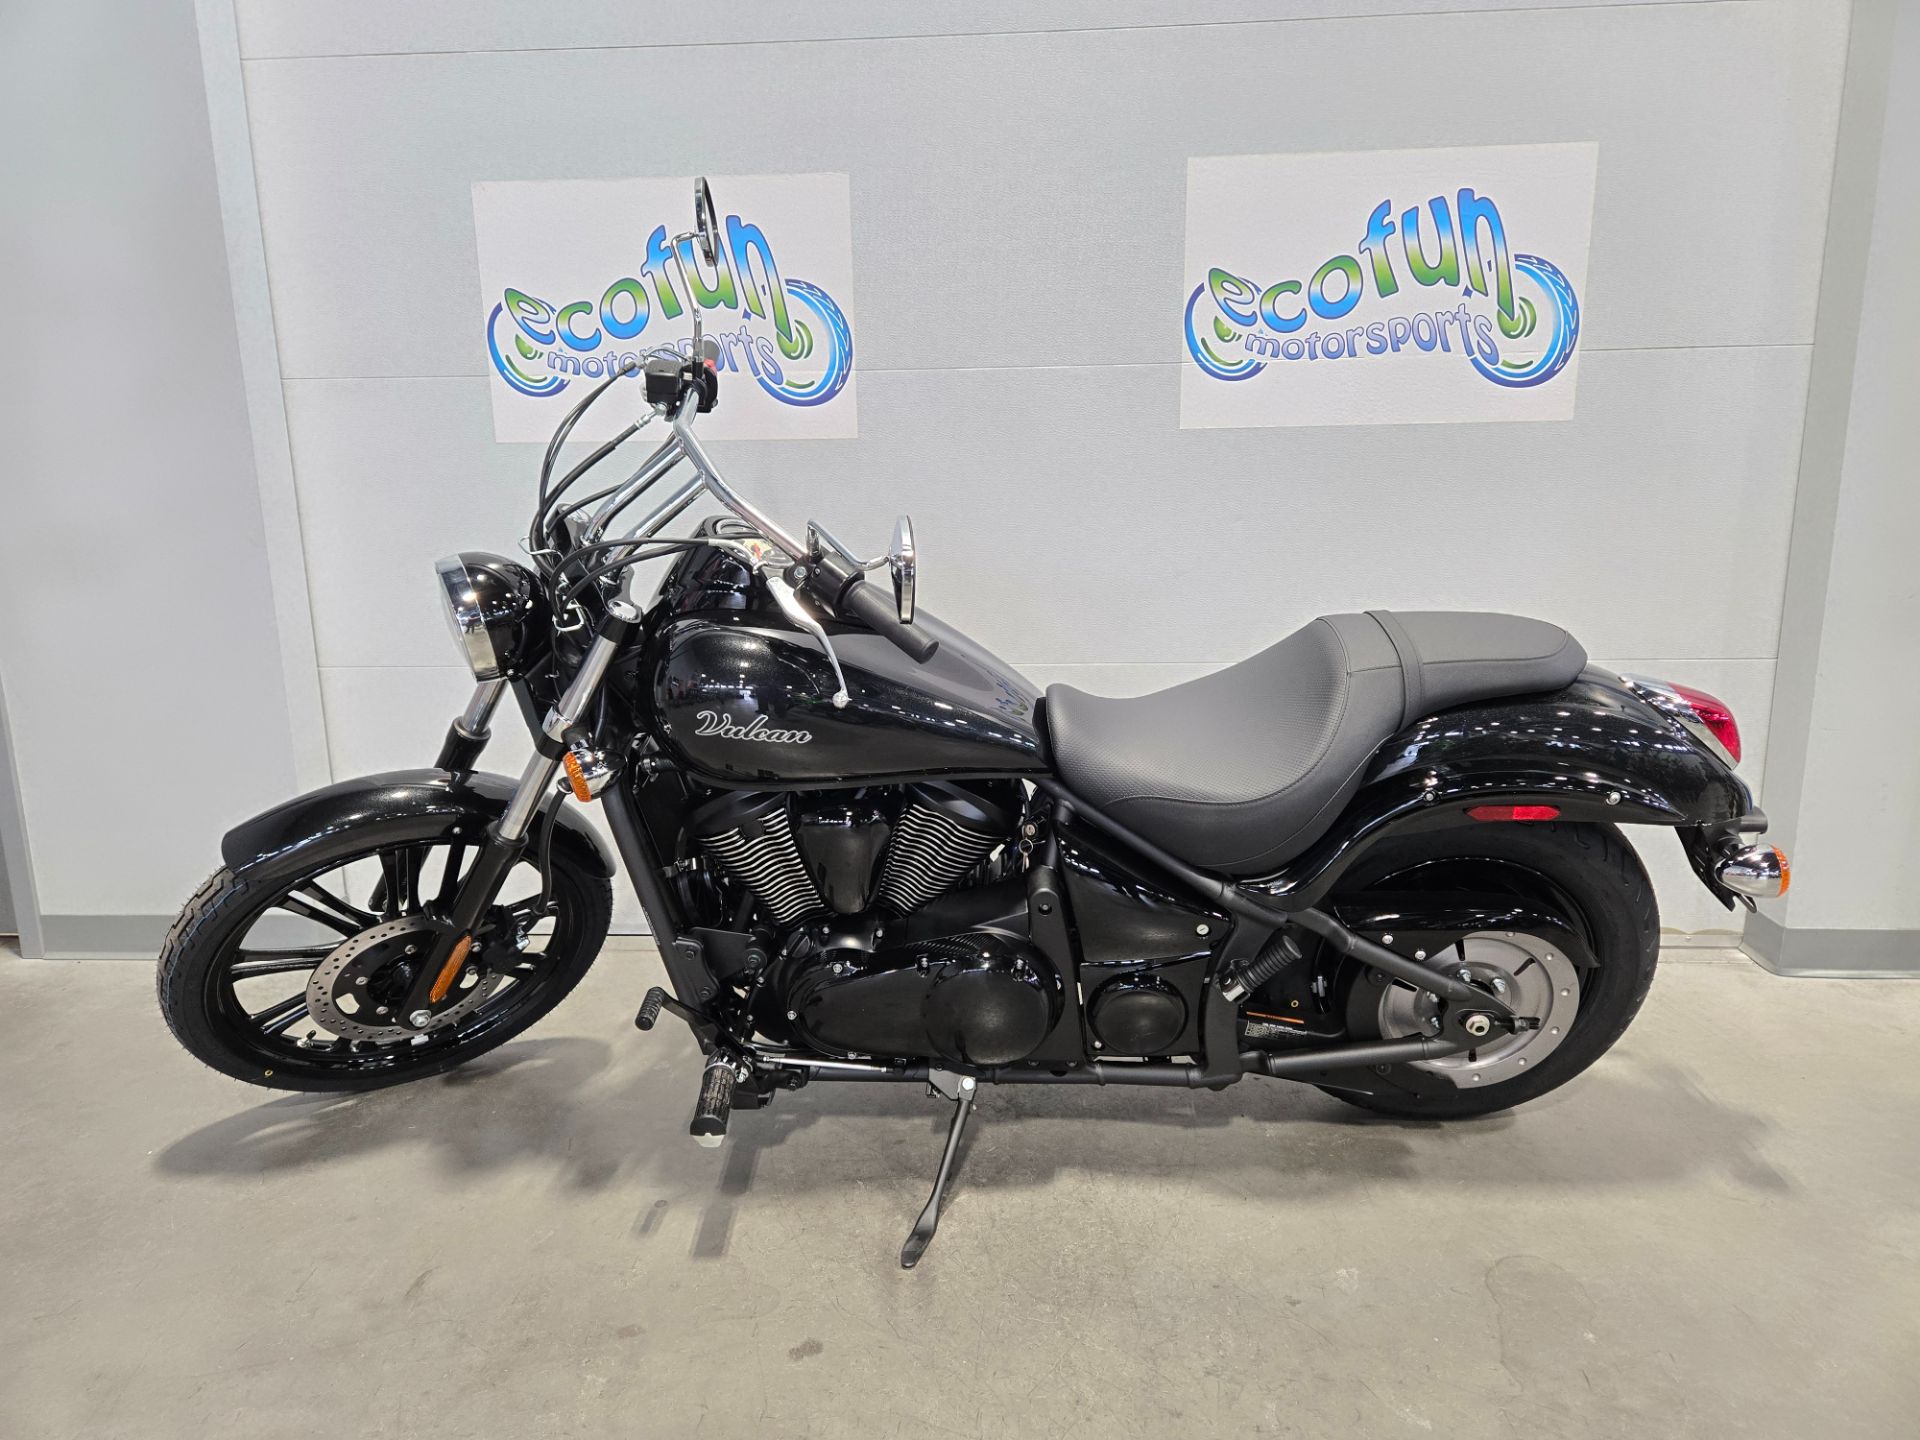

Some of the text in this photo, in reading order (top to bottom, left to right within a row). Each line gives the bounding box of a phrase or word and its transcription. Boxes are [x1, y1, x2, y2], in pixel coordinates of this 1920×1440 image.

[1208, 188, 1514, 333] ecofun
[547, 326, 784, 386] motorts
[1244, 303, 1500, 366] motorsports
[694, 710, 812, 744] Vulcan
